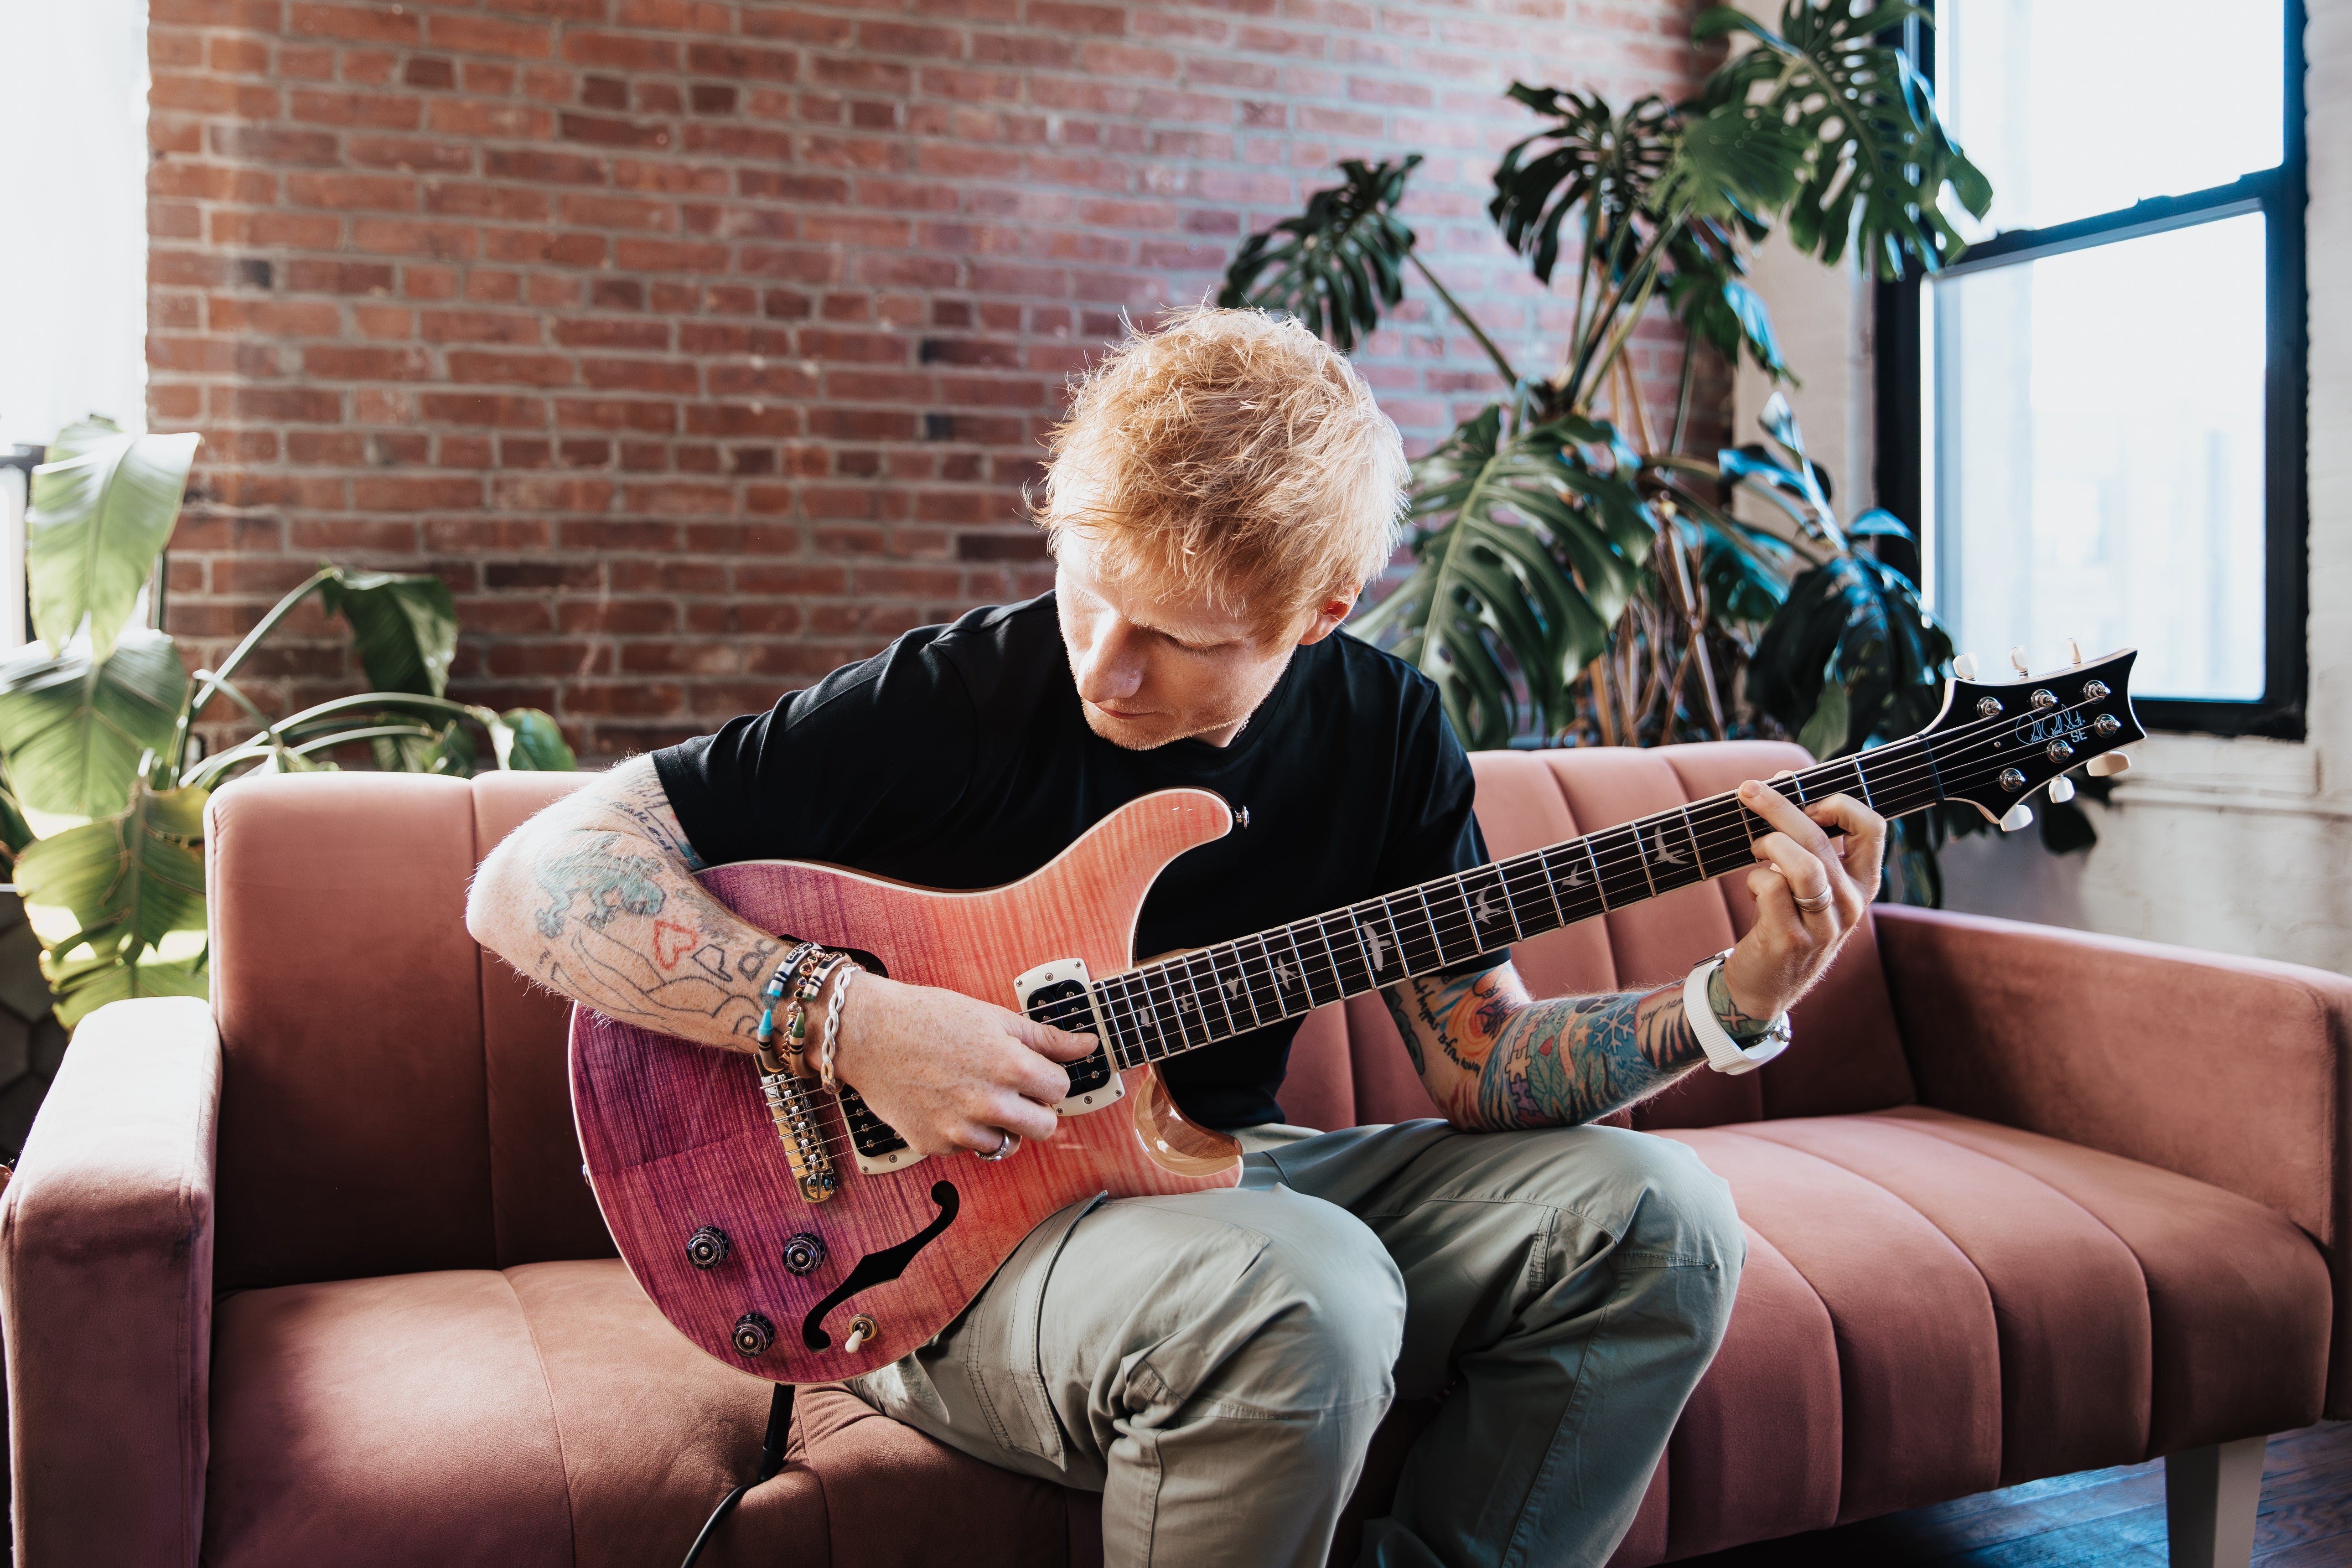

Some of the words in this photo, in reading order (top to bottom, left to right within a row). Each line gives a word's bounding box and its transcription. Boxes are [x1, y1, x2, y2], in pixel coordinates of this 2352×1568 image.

[2015, 714, 2046, 745] Paul
[2041, 713, 2064, 737] Reed
[2062, 704, 2083, 732] Smith
[2070, 730, 2088, 743] SE
